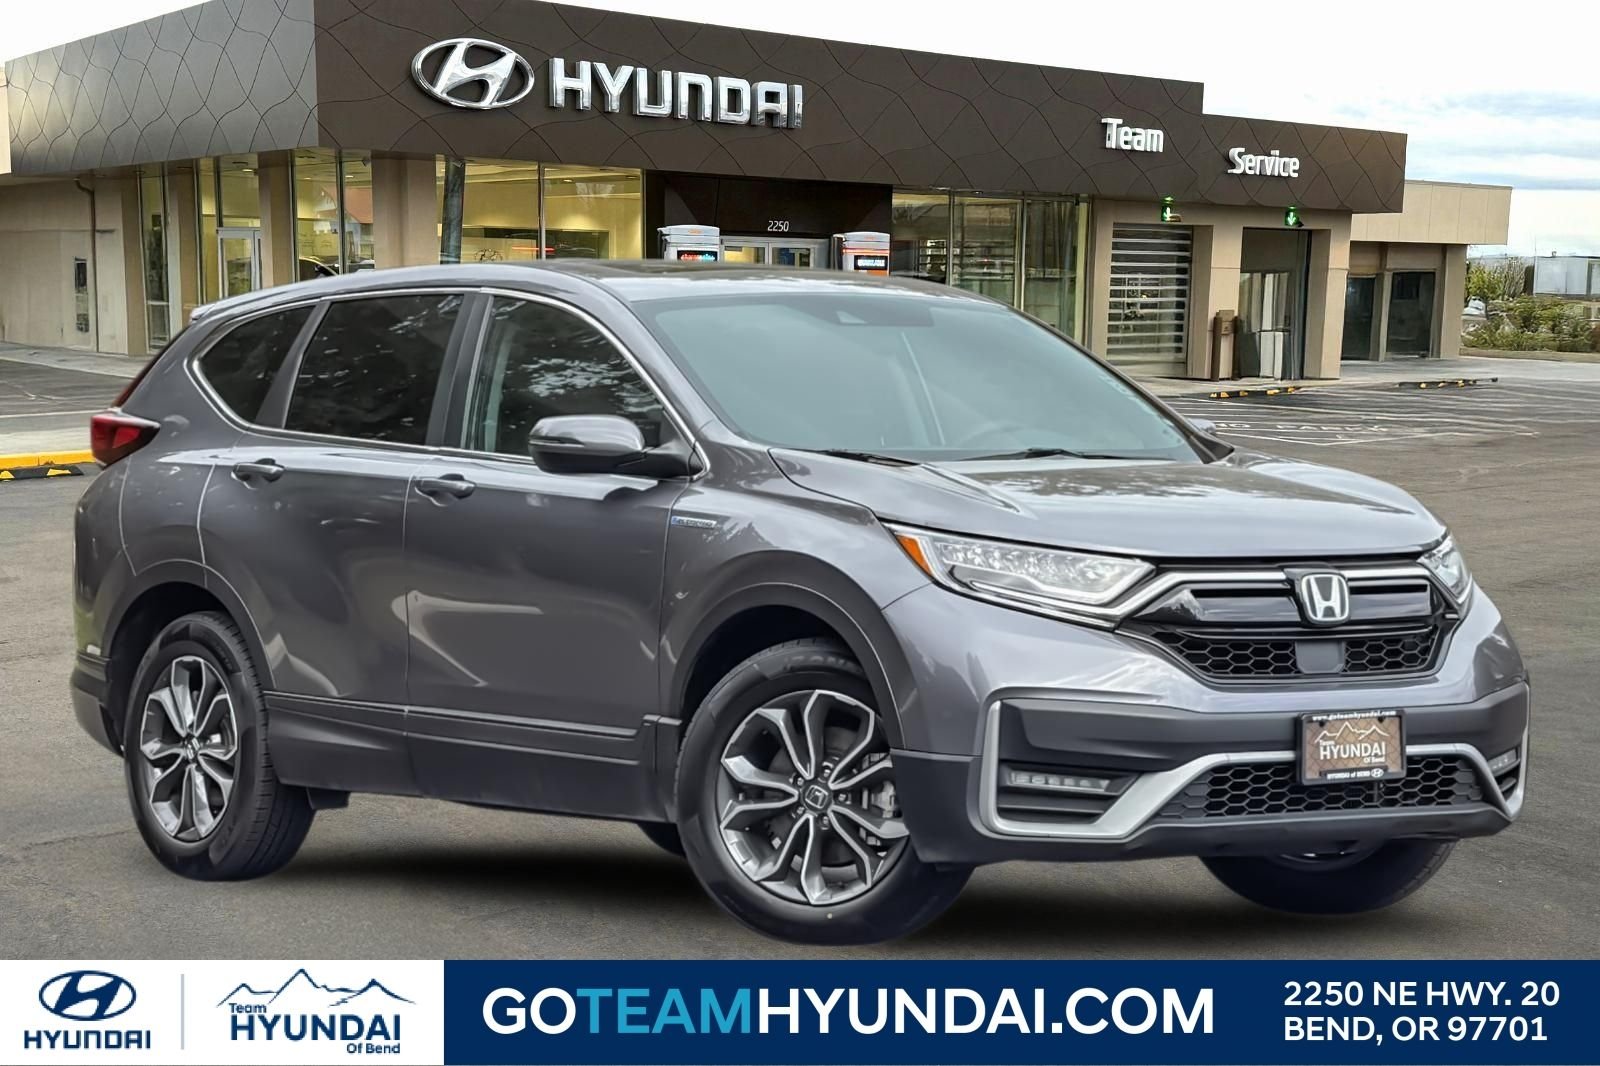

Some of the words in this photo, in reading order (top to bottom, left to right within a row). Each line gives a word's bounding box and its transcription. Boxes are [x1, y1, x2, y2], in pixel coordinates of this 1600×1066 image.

[549, 57, 803, 128] HYUNDAI
[1101, 117, 1164, 153] Team
[1228, 147, 1300, 178] Service
[767, 220, 790, 232] 2250
[1320, 741, 1386, 760] HYUNDAI
